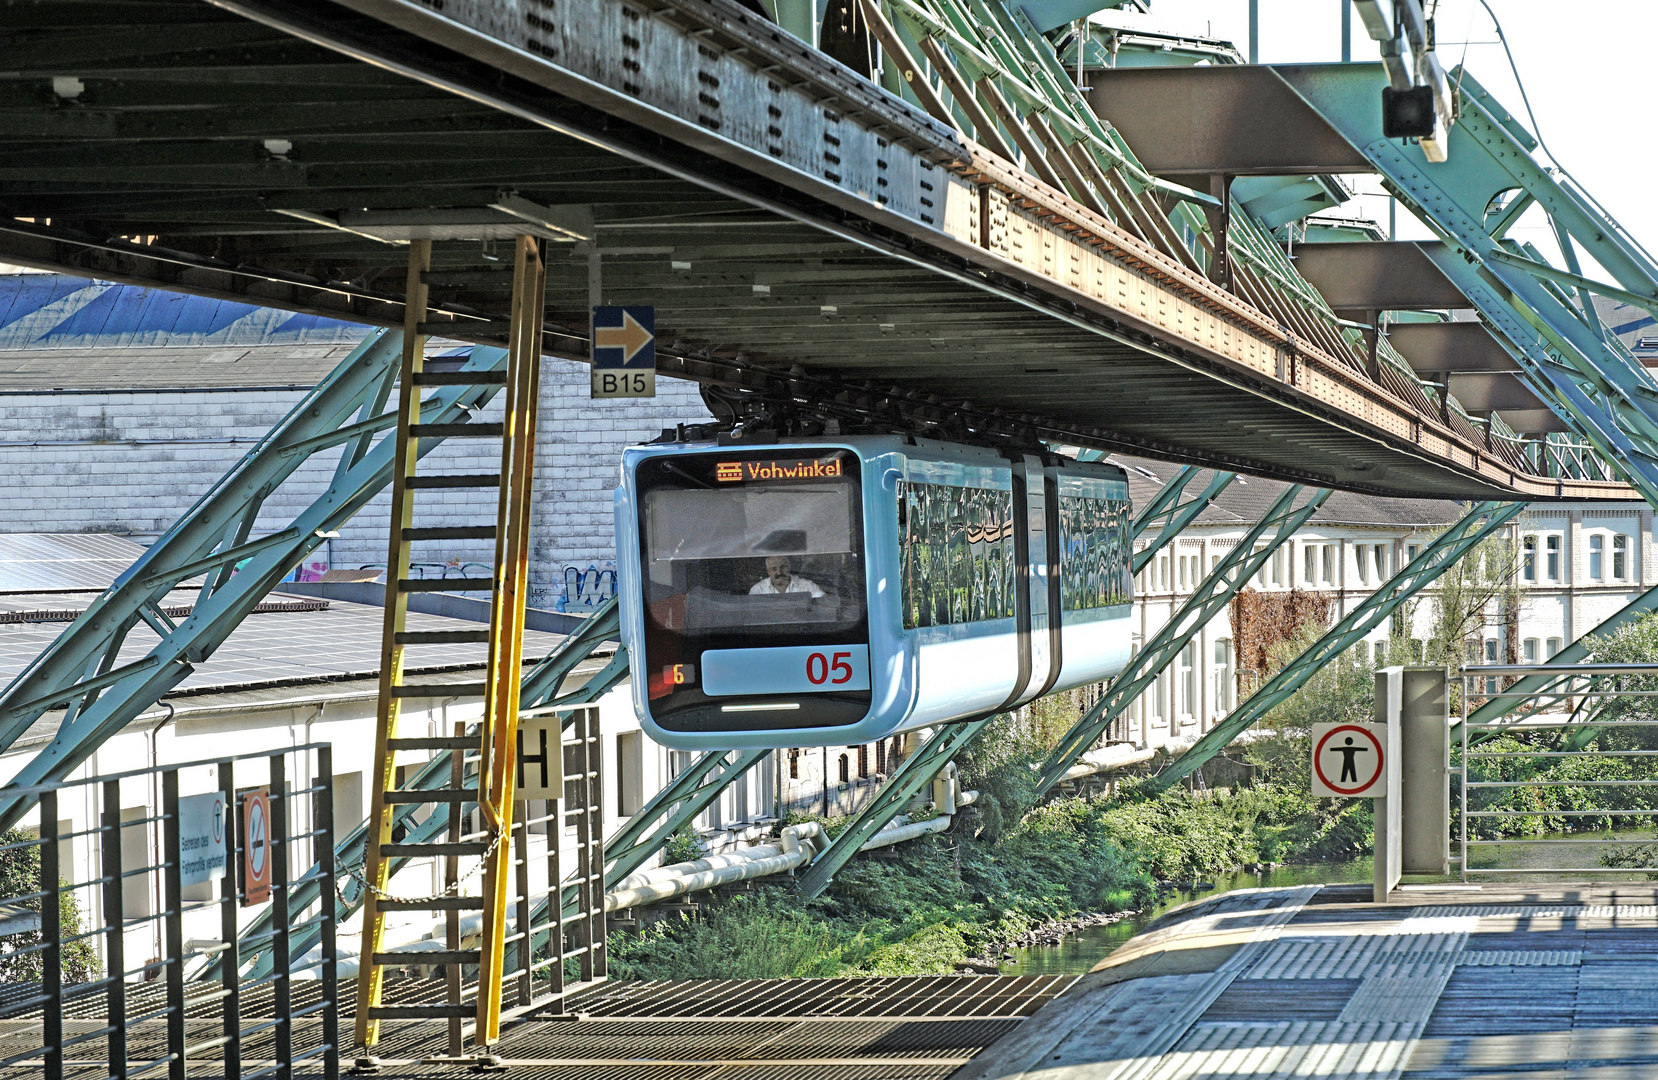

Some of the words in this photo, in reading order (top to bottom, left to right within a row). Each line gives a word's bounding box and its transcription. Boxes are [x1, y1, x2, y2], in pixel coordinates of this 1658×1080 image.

[603, 373, 646, 393] B15
[747, 459, 841, 479] Vohwinkel
[806, 652, 853, 685] 05
[516, 729, 548, 788] H
